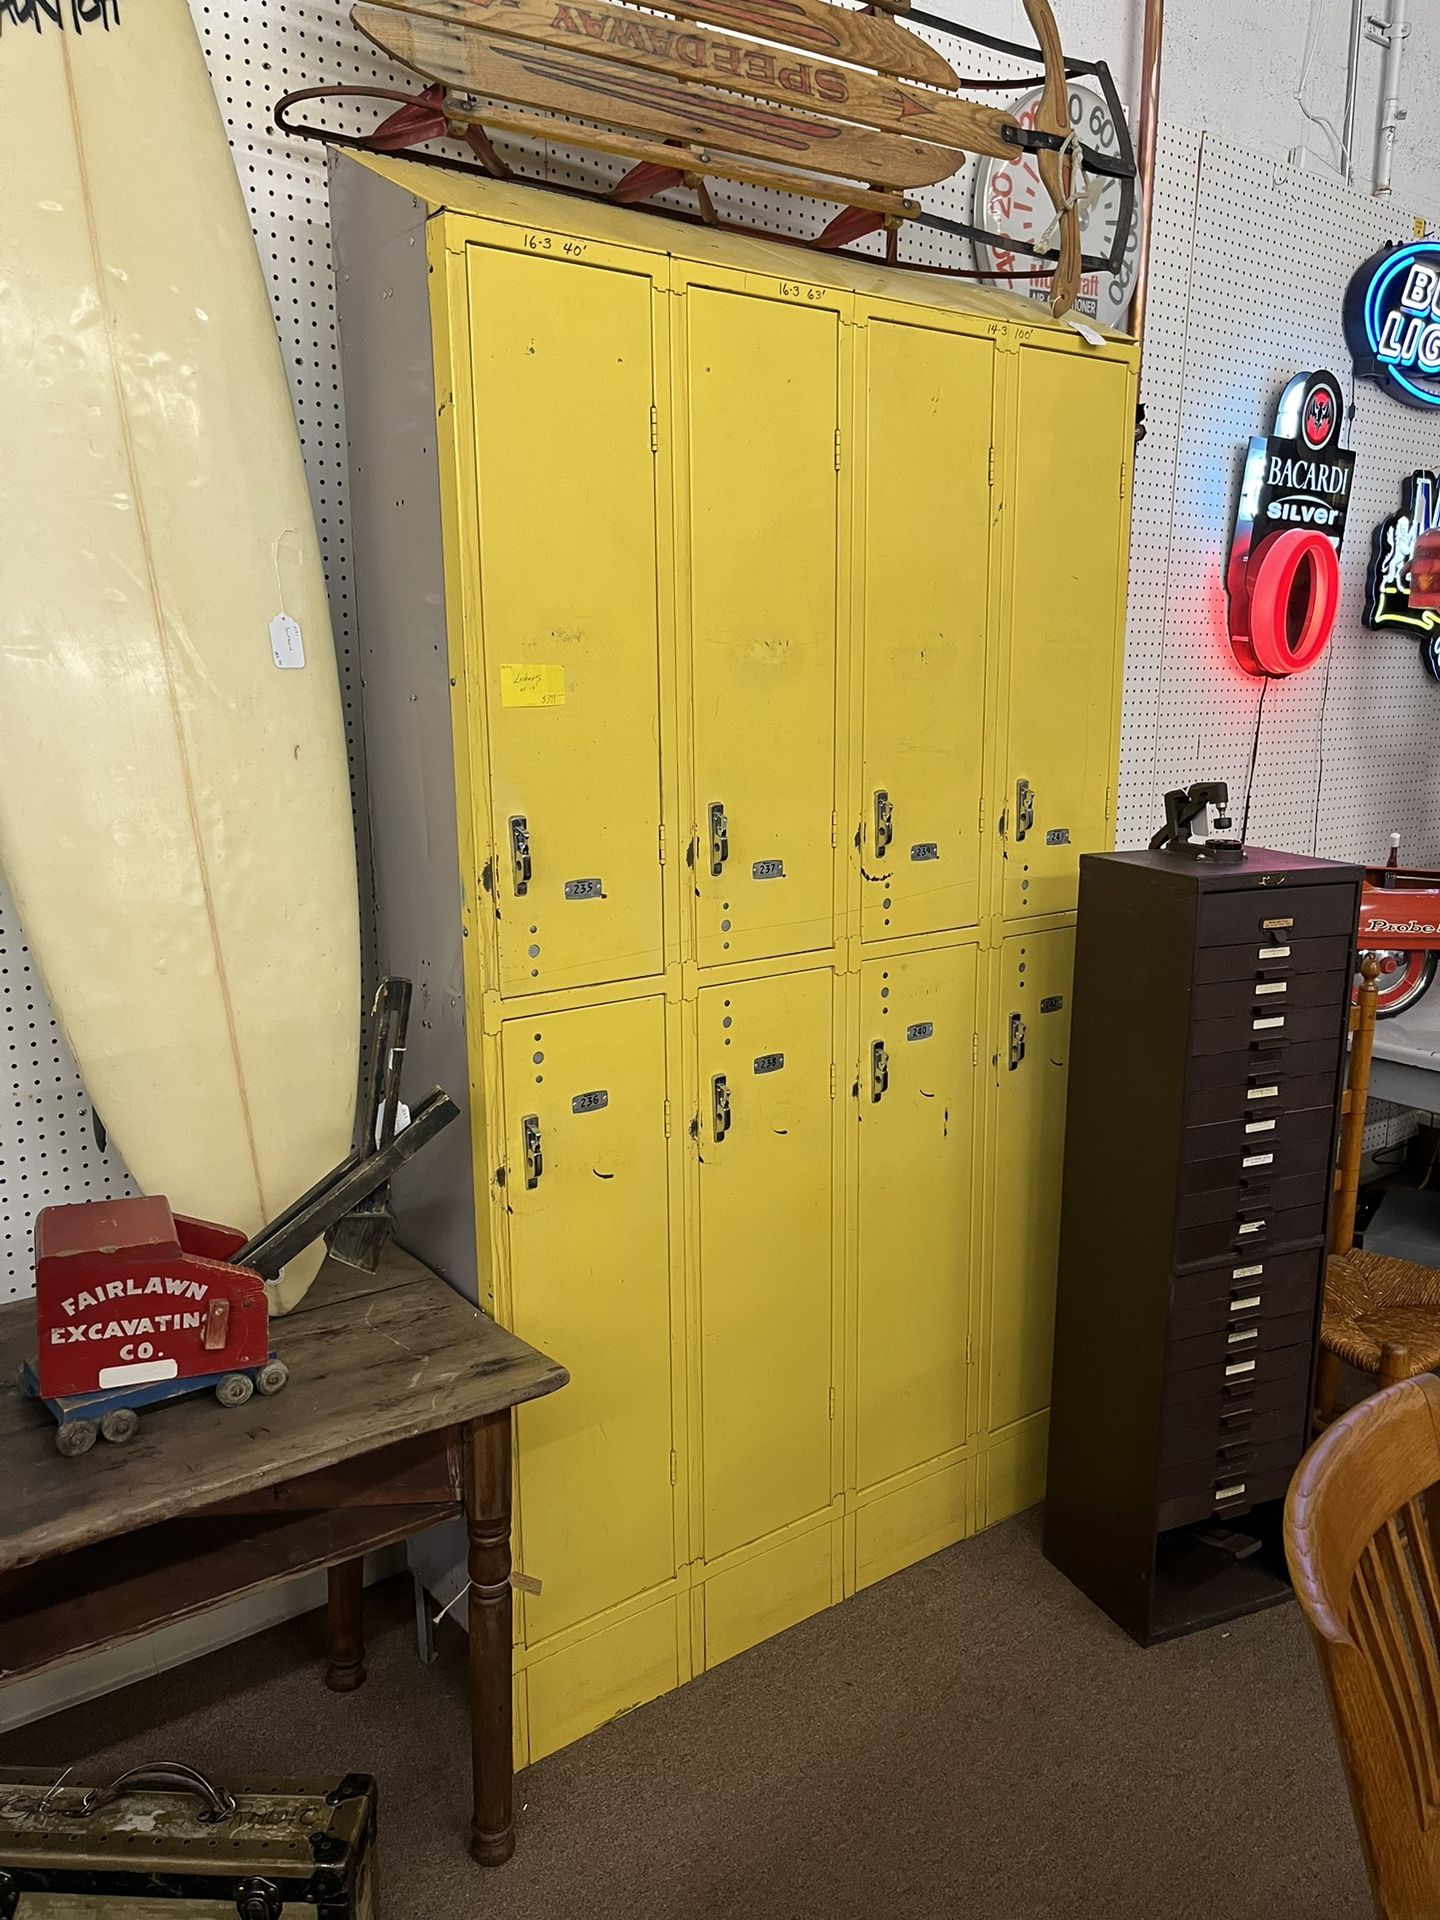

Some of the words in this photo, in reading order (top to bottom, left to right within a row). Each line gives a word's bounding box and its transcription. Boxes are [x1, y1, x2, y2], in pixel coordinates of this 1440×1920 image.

[548, 4, 850, 103] SPEEDAWAY
[1089, 105, 1115, 148] 60
[1267, 455, 1349, 495] BACARDI
[917, 847, 931, 857] 239
[759, 863, 776, 875] 237
[573, 882, 593, 895] 235
[1365, 918, 1435, 933] Probe
[912, 1026, 927, 1037] 240
[760, 1056, 777, 1069] 238
[580, 1094, 599, 1108] 236
[60, 1276, 209, 1317] FAIRLAWN
[50, 1311, 208, 1345] EXCAVATIN
[119, 1342, 164, 1361] CO.
